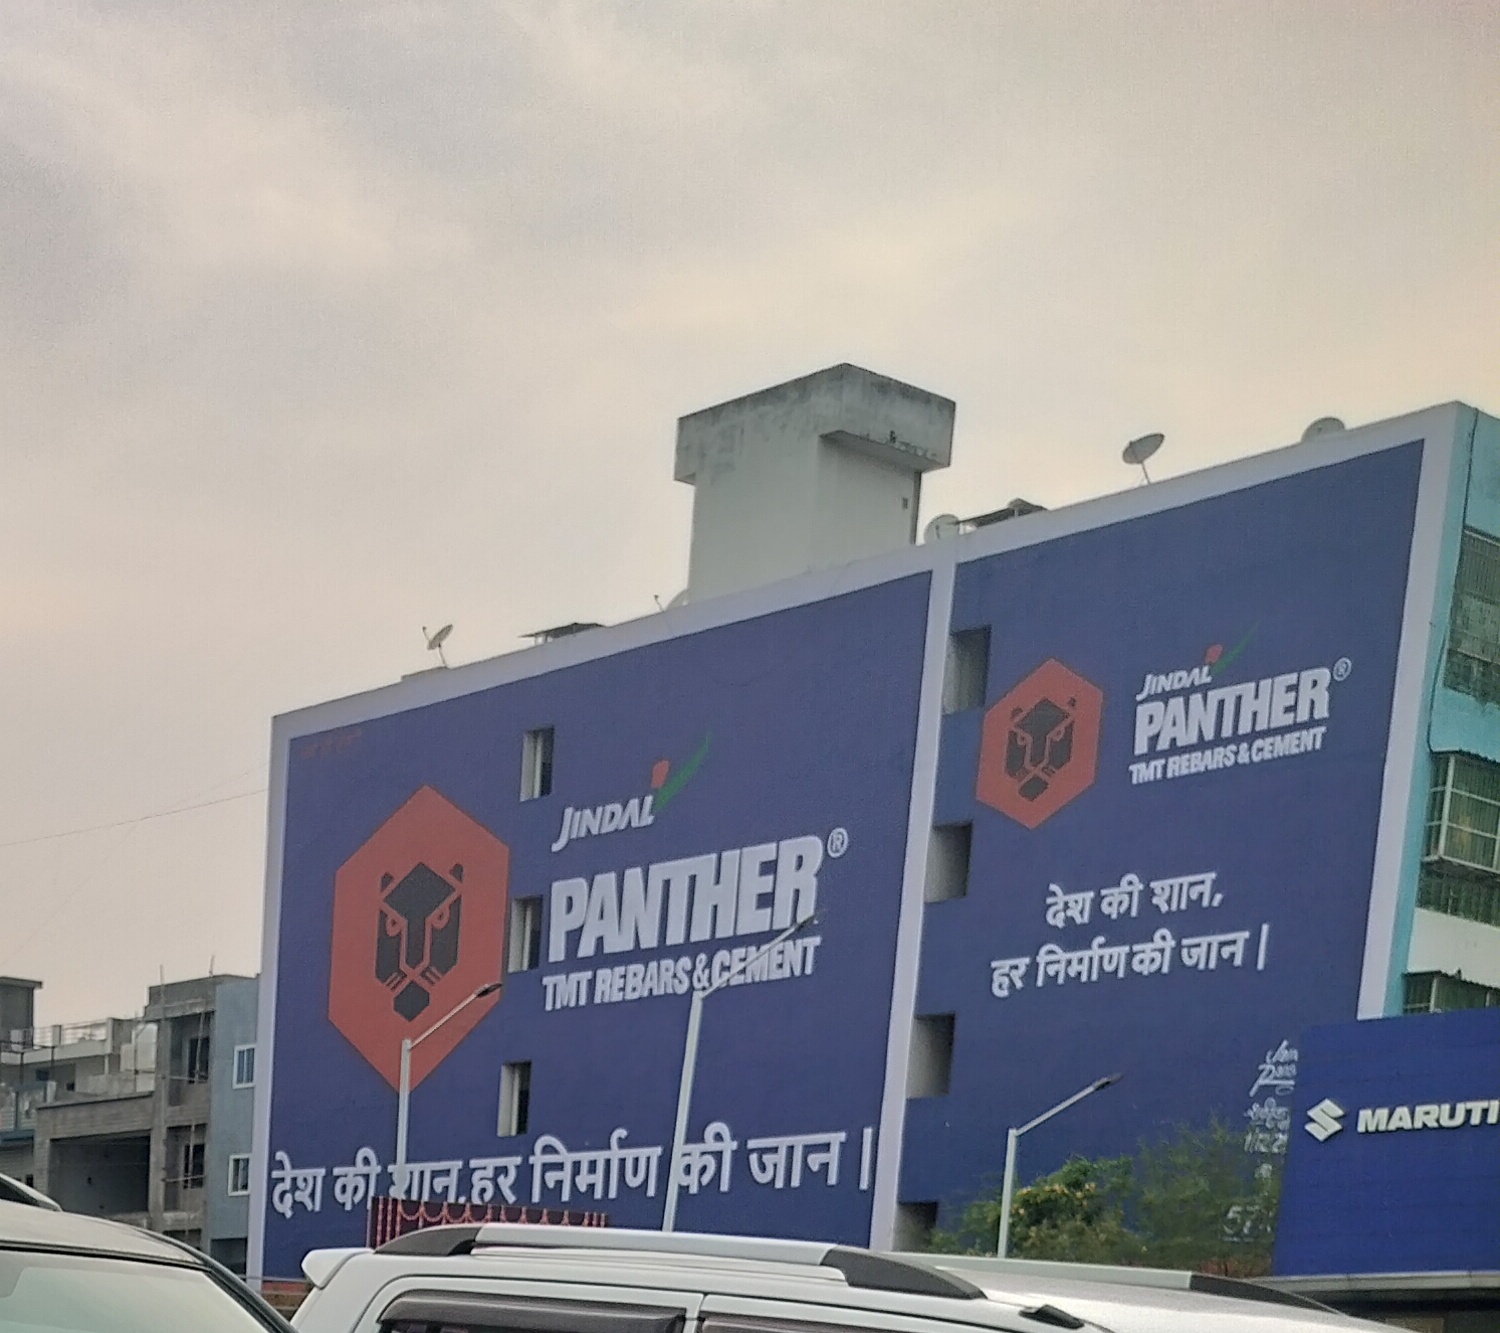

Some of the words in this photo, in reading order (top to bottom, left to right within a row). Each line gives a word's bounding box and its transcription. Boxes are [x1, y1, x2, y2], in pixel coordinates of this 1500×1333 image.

[1136, 665, 1212, 701] JINDAL
[1128, 758, 1166, 785] TMT
[551, 794, 656, 852] JINDAL
[1046, 883, 1095, 928] देश
[1100, 873, 1144, 919] की
[990, 956, 1030, 997] हर
[1036, 936, 1130, 987] निर्माण
[1131, 927, 1176, 975] की
[542, 969, 593, 1012] TMT
[1357, 1099, 1499, 1133] MARUTI
[271, 1151, 326, 1218] देश
[332, 1147, 381, 1211] की
[529, 1128, 663, 1203] निर्माण
[677, 1121, 738, 1195] की
